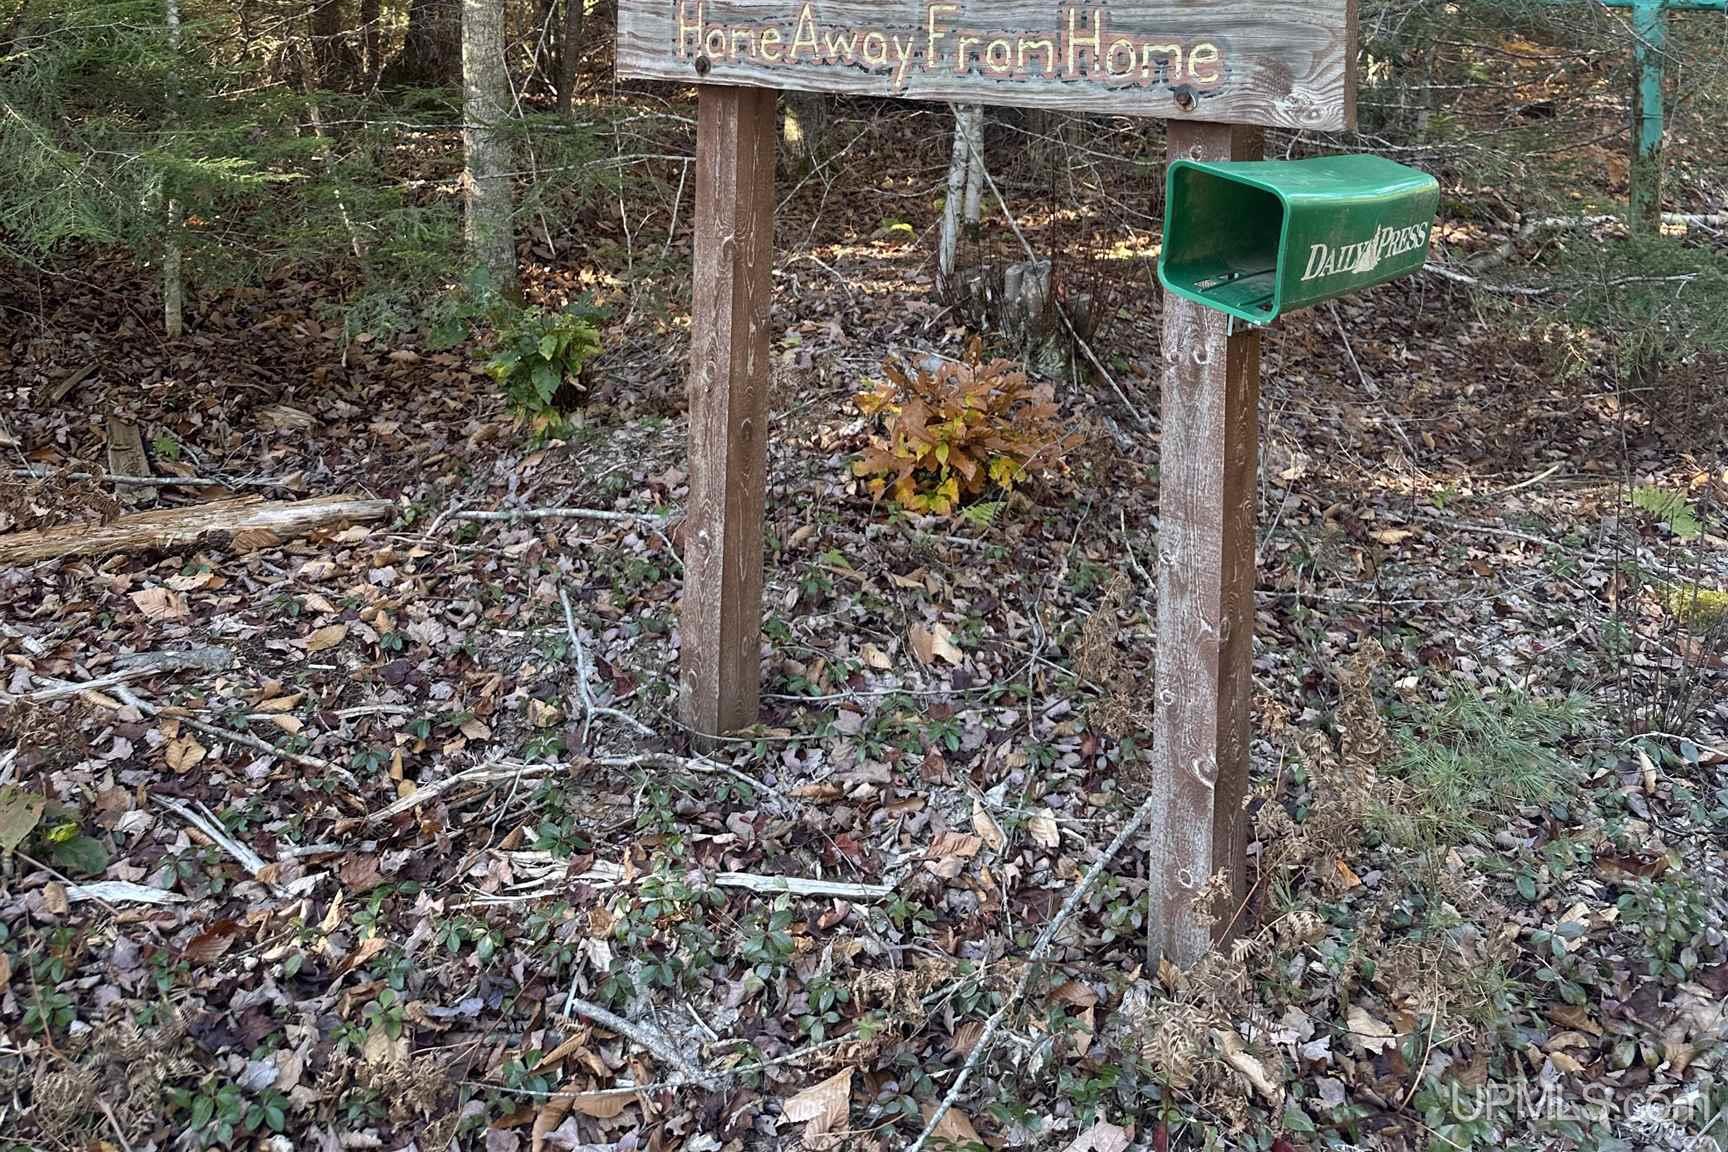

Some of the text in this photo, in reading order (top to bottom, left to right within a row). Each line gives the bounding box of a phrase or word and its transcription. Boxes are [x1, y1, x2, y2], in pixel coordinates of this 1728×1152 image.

[678, 0, 1220, 89] Home Away From Home
[1374, 221, 1428, 262] PRESS
